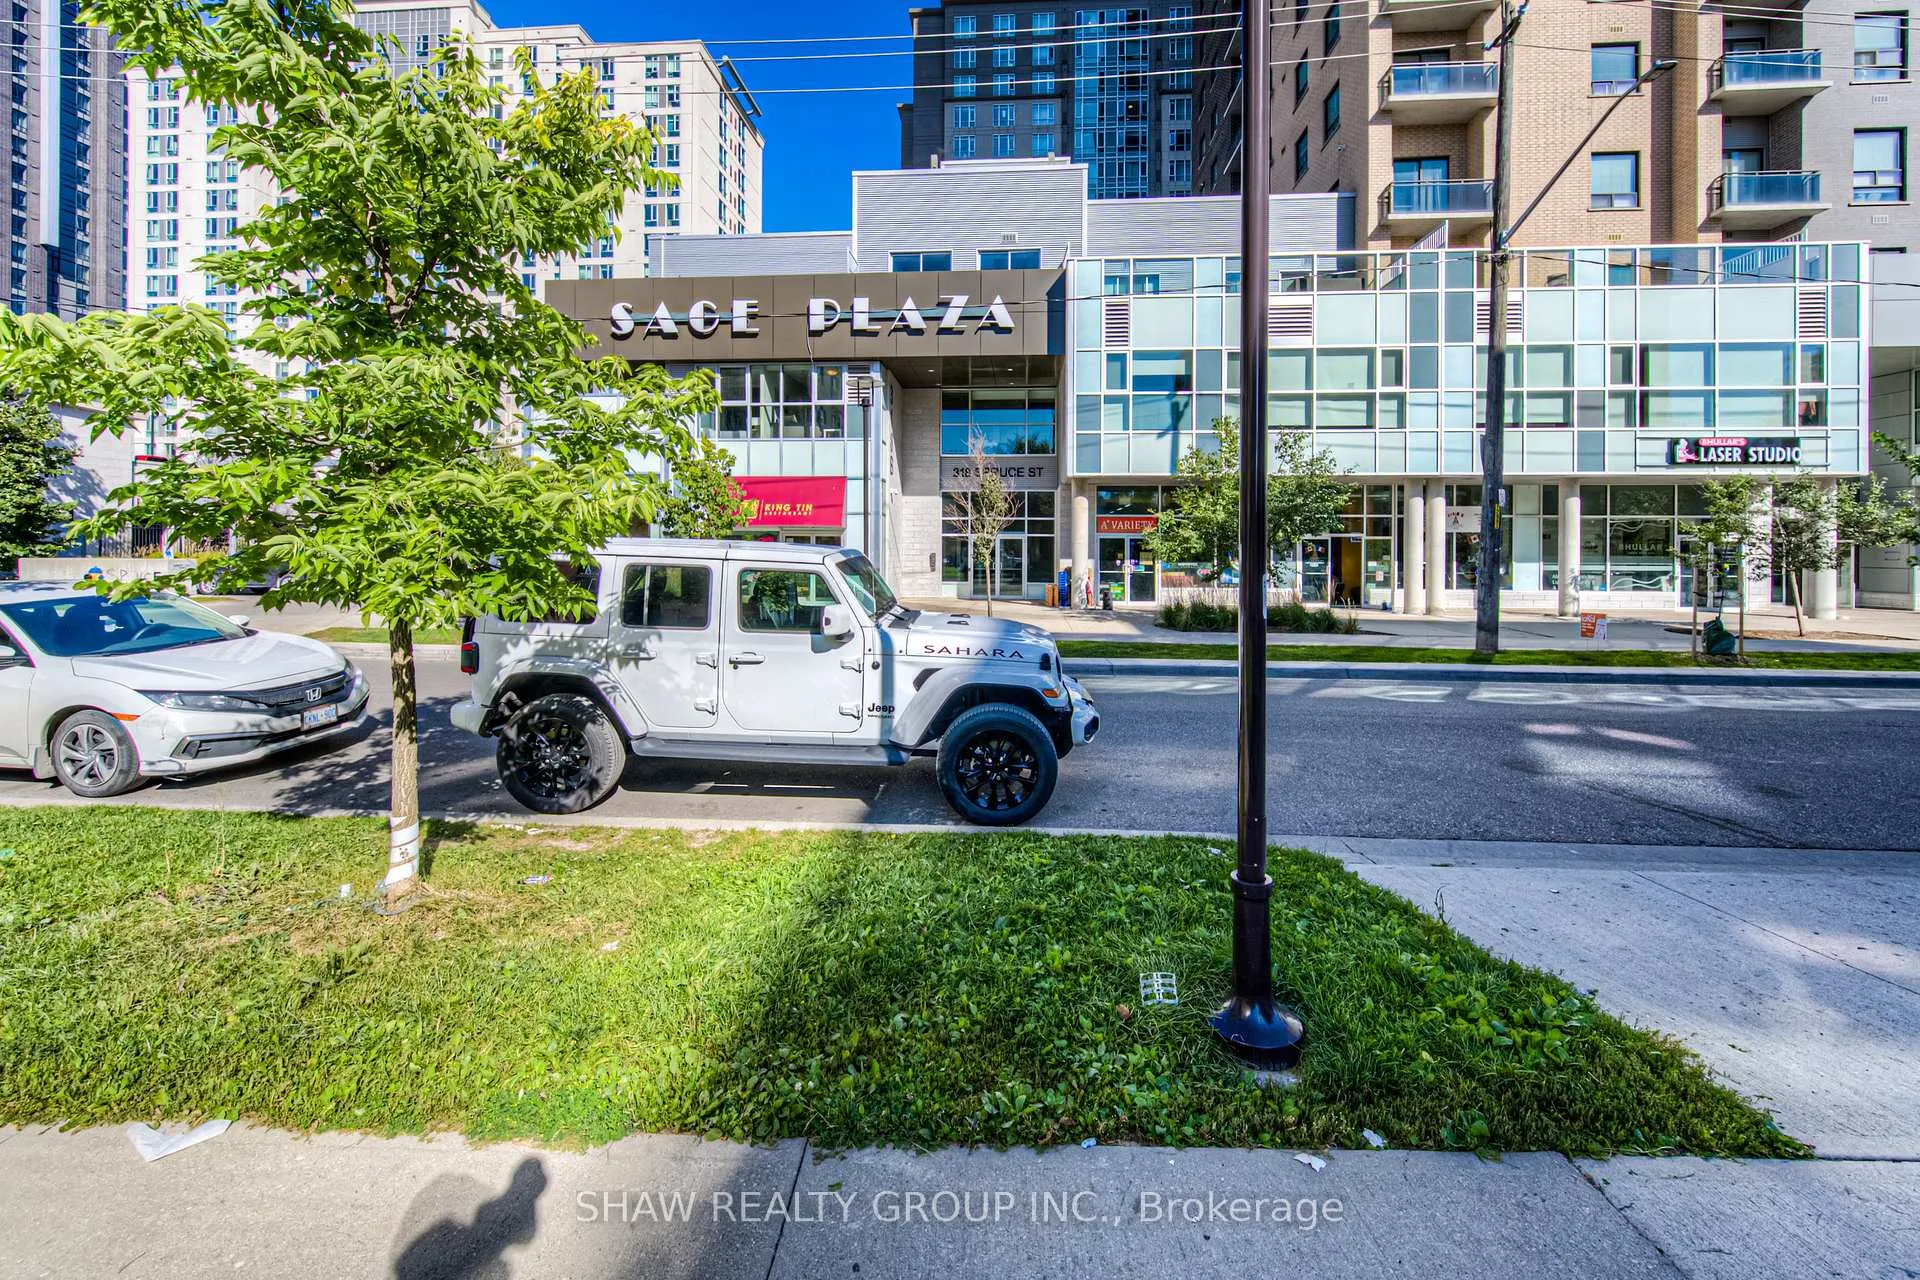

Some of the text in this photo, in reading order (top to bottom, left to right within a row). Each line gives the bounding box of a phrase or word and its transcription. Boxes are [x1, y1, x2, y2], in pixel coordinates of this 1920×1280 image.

[609, 294, 1016, 337] SAGE PLAZA
[1700, 446, 1802, 462] LASER STUDIO
[953, 467, 971, 478] 318
[1028, 467, 1044, 478] ST
[765, 503, 792, 512] KING
[796, 503, 813, 512] TIN
[1111, 519, 1154, 530] VARIETY
[923, 644, 1024, 659] SAHARA
[867, 702, 896, 715] Jeep
